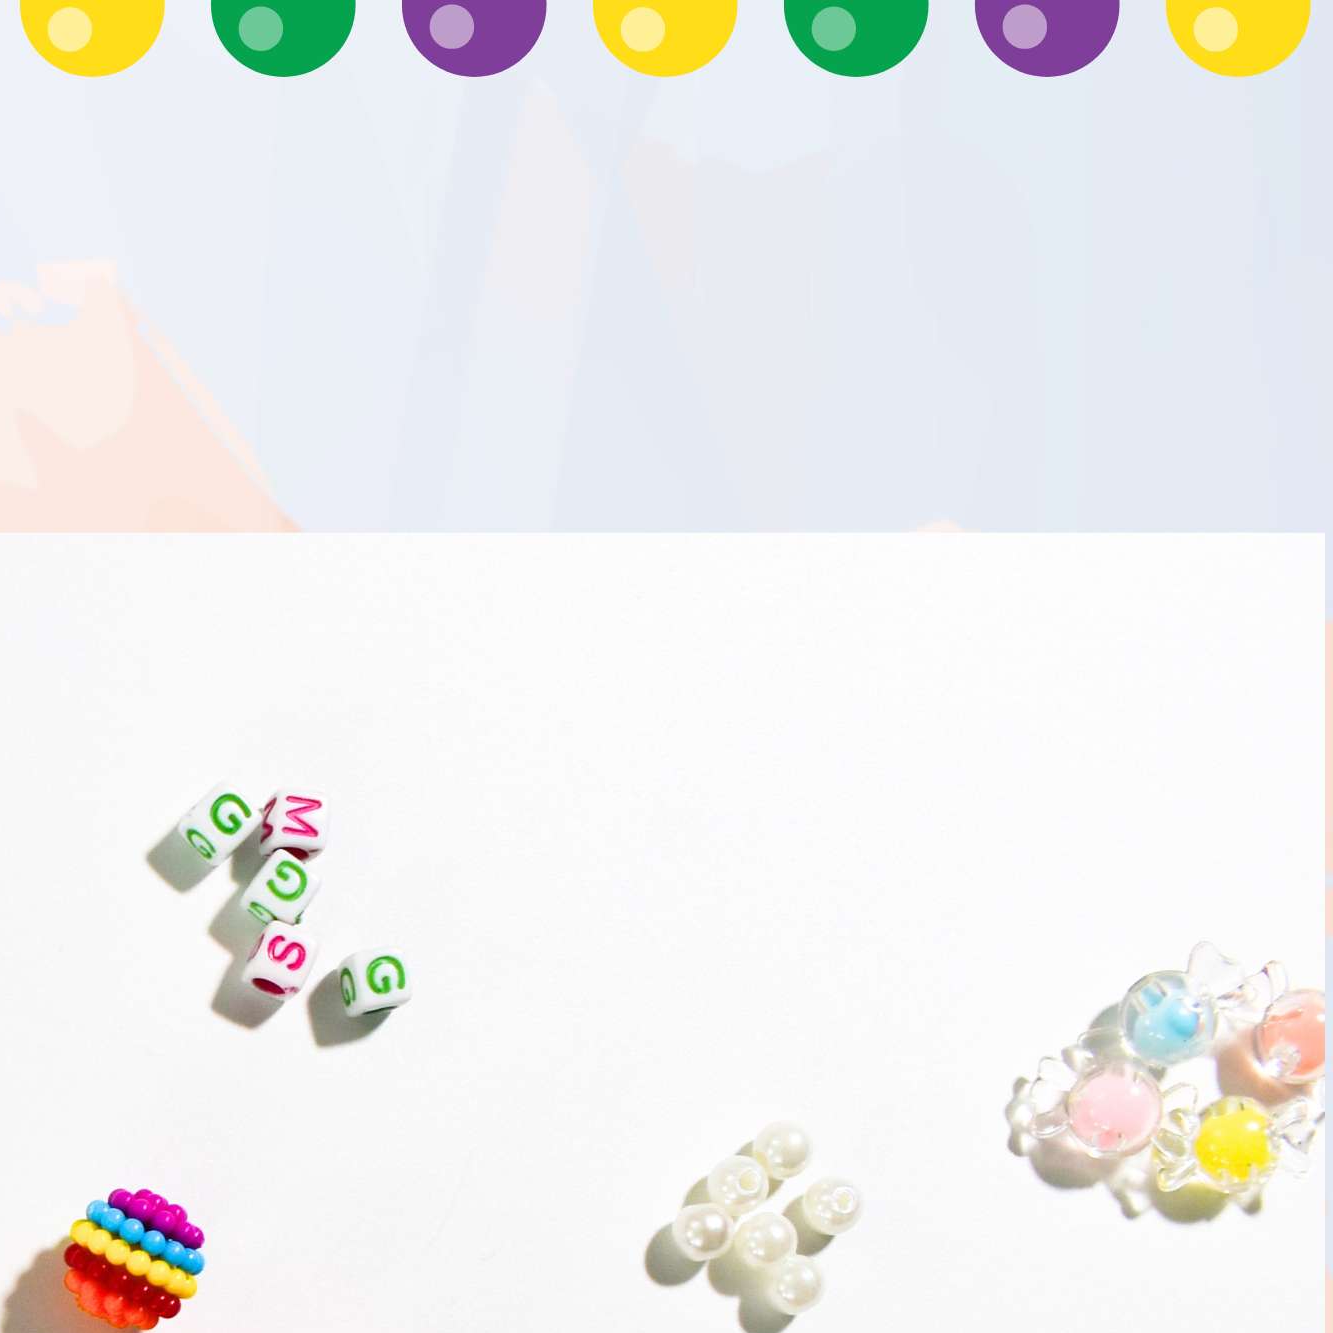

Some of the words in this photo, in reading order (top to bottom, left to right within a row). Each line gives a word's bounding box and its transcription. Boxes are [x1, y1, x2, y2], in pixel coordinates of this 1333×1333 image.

[209, 793, 252, 836] G
[266, 860, 308, 902] G
[267, 934, 307, 972] S
[365, 955, 406, 995] G
